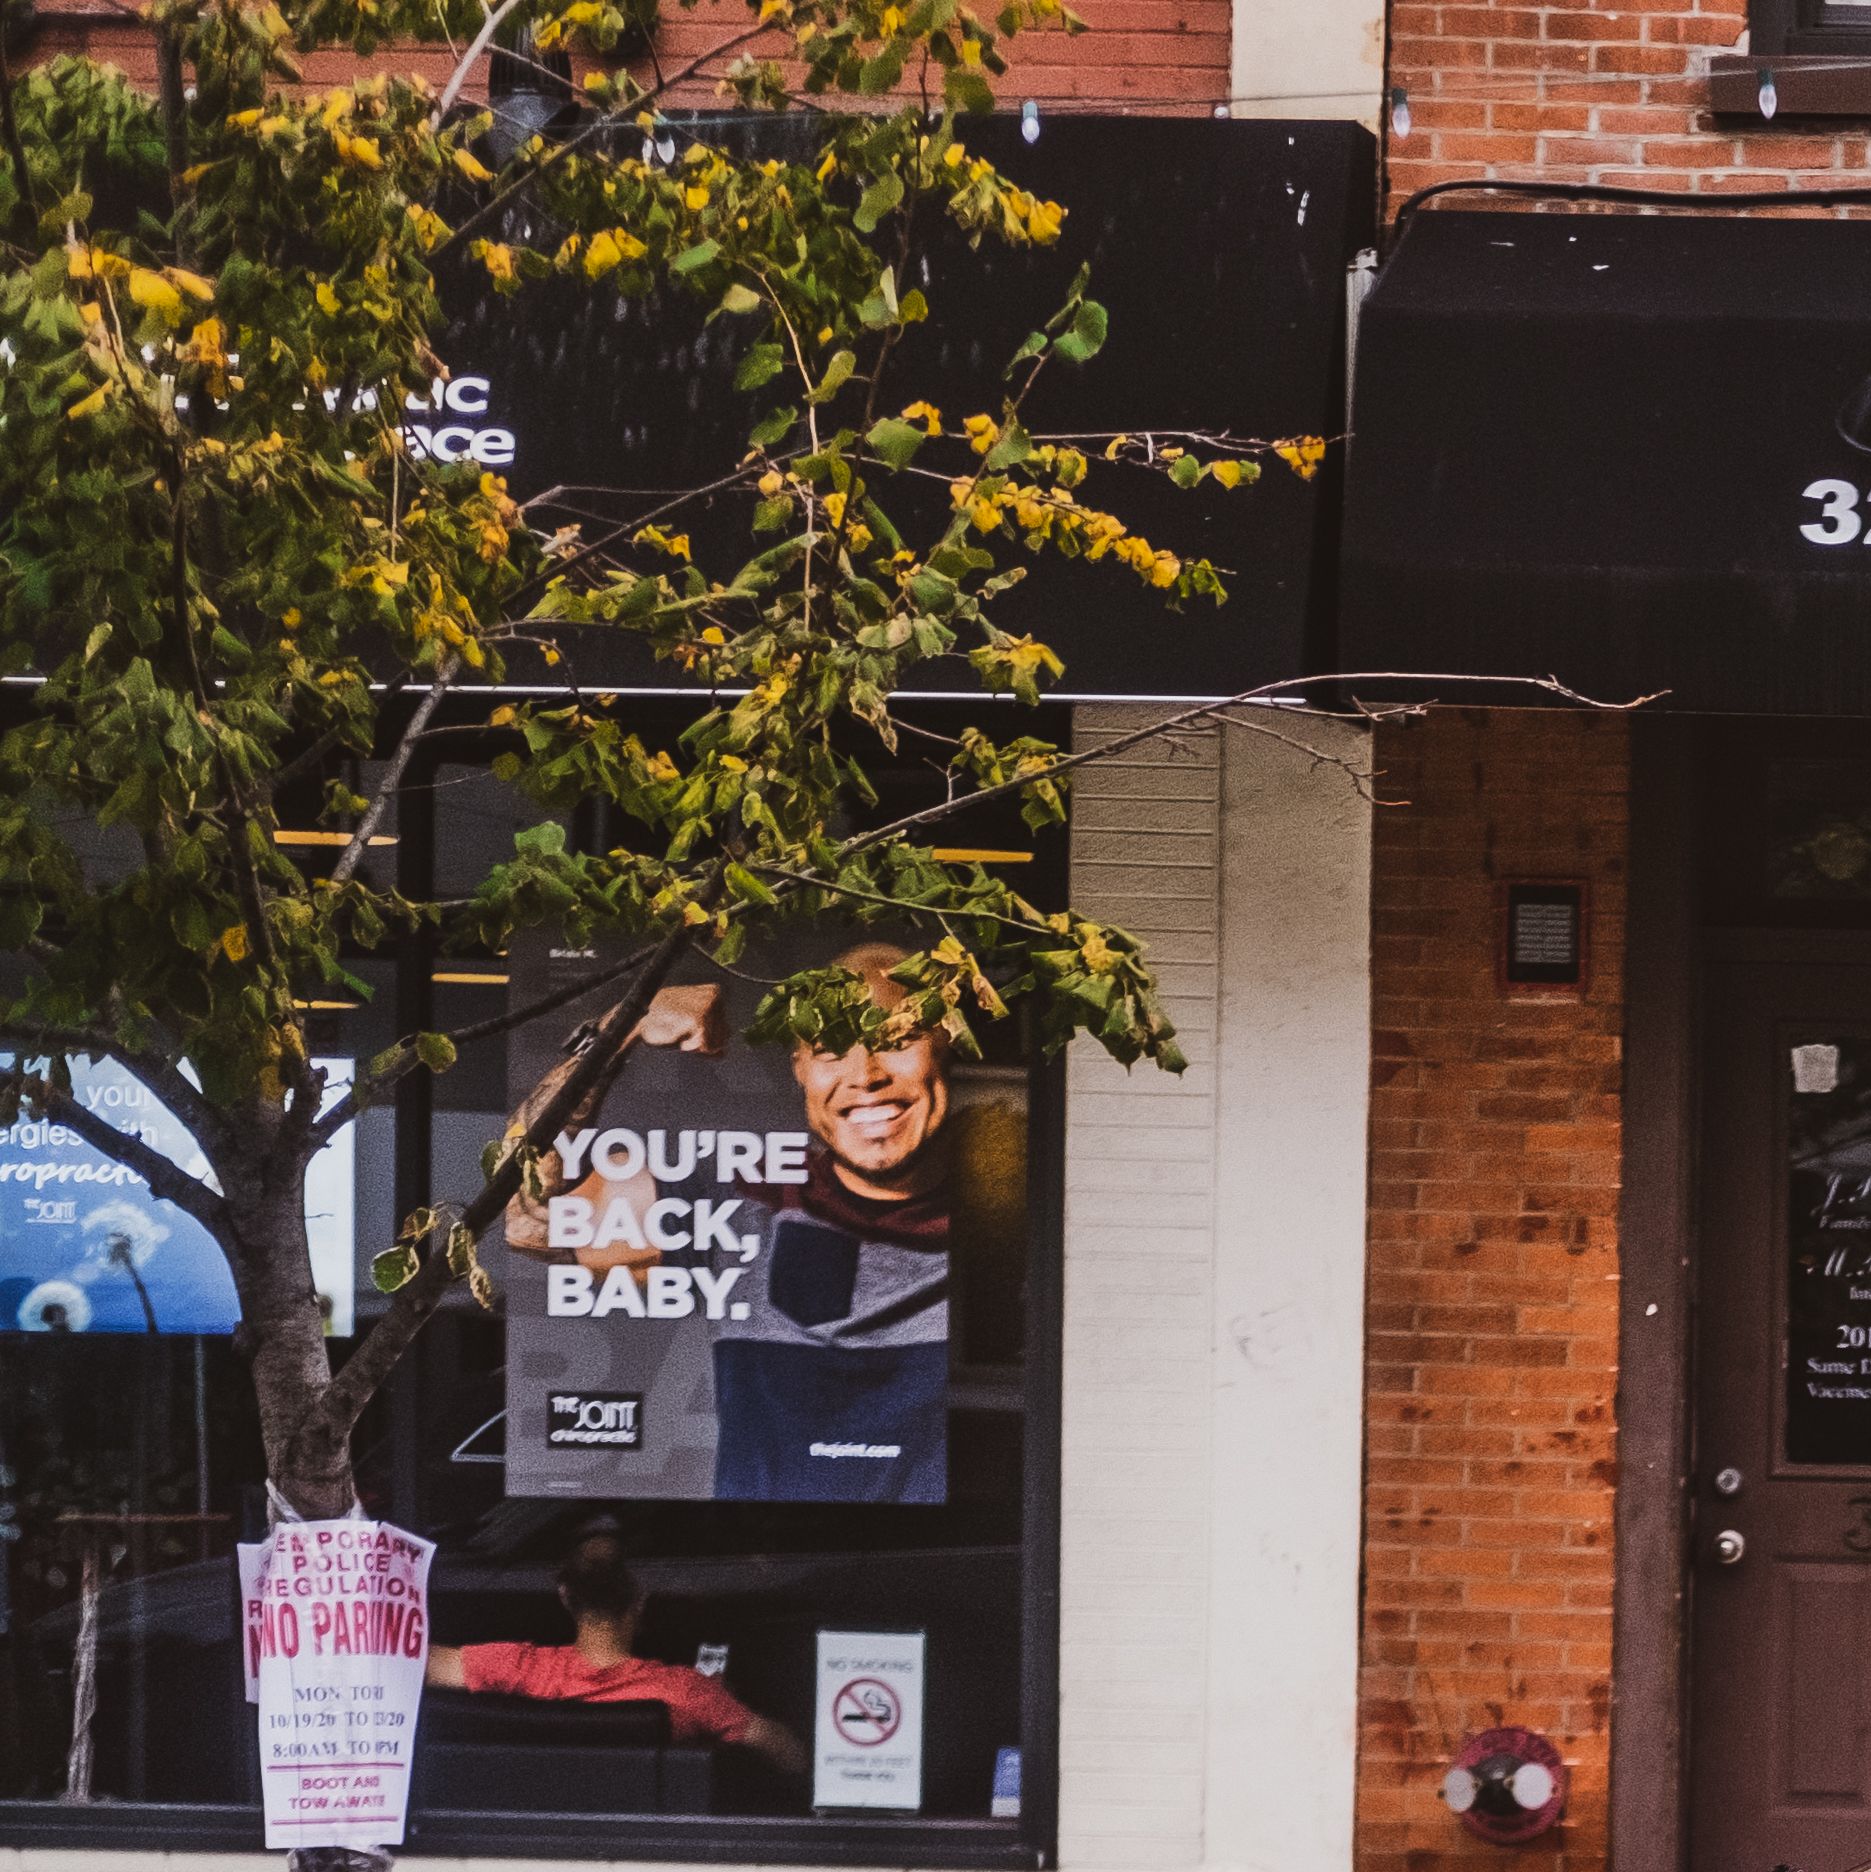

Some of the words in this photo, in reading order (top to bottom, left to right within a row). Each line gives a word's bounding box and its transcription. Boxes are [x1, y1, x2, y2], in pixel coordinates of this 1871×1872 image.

[552, 1128, 810, 1184] YOU'RE
[547, 1197, 760, 1264] BACK,
[546, 1265, 752, 1321] BABY.
[575, 1400, 638, 1430] JOINT
[293, 1553, 392, 1573] POLICE
[262, 1602, 300, 1659] NO
[295, 1686, 341, 1703] MON
[273, 1740, 338, 1758] 8:00AM
[302, 1777, 349, 1790] BOOT
[288, 1797, 329, 1810] TOW
